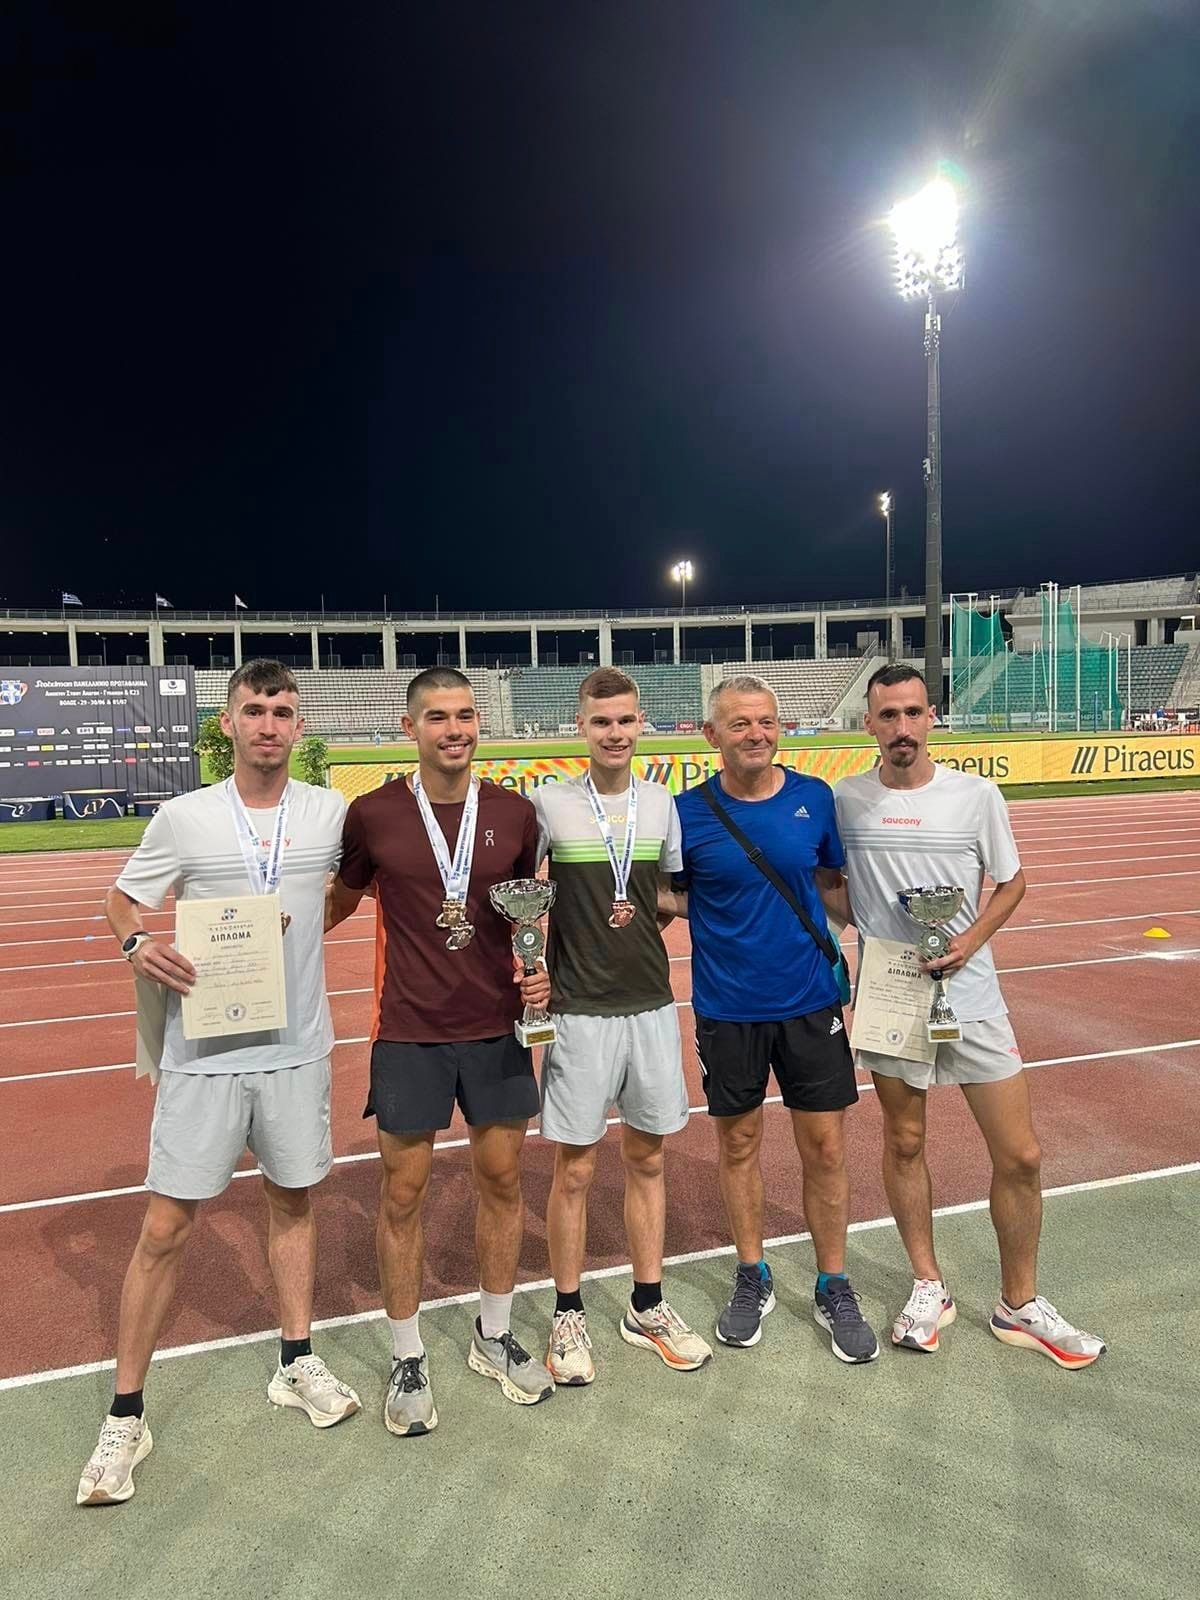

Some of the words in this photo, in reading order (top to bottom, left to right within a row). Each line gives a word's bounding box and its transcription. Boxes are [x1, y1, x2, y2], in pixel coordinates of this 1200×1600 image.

[1103, 745, 1195, 773] Piraeus
[882, 816, 922, 827] saucony
[210, 931, 252, 943] ΔΙΠΛΩΜΑ
[888, 968, 922, 979] ΔΙΠΛΩΜΑ
